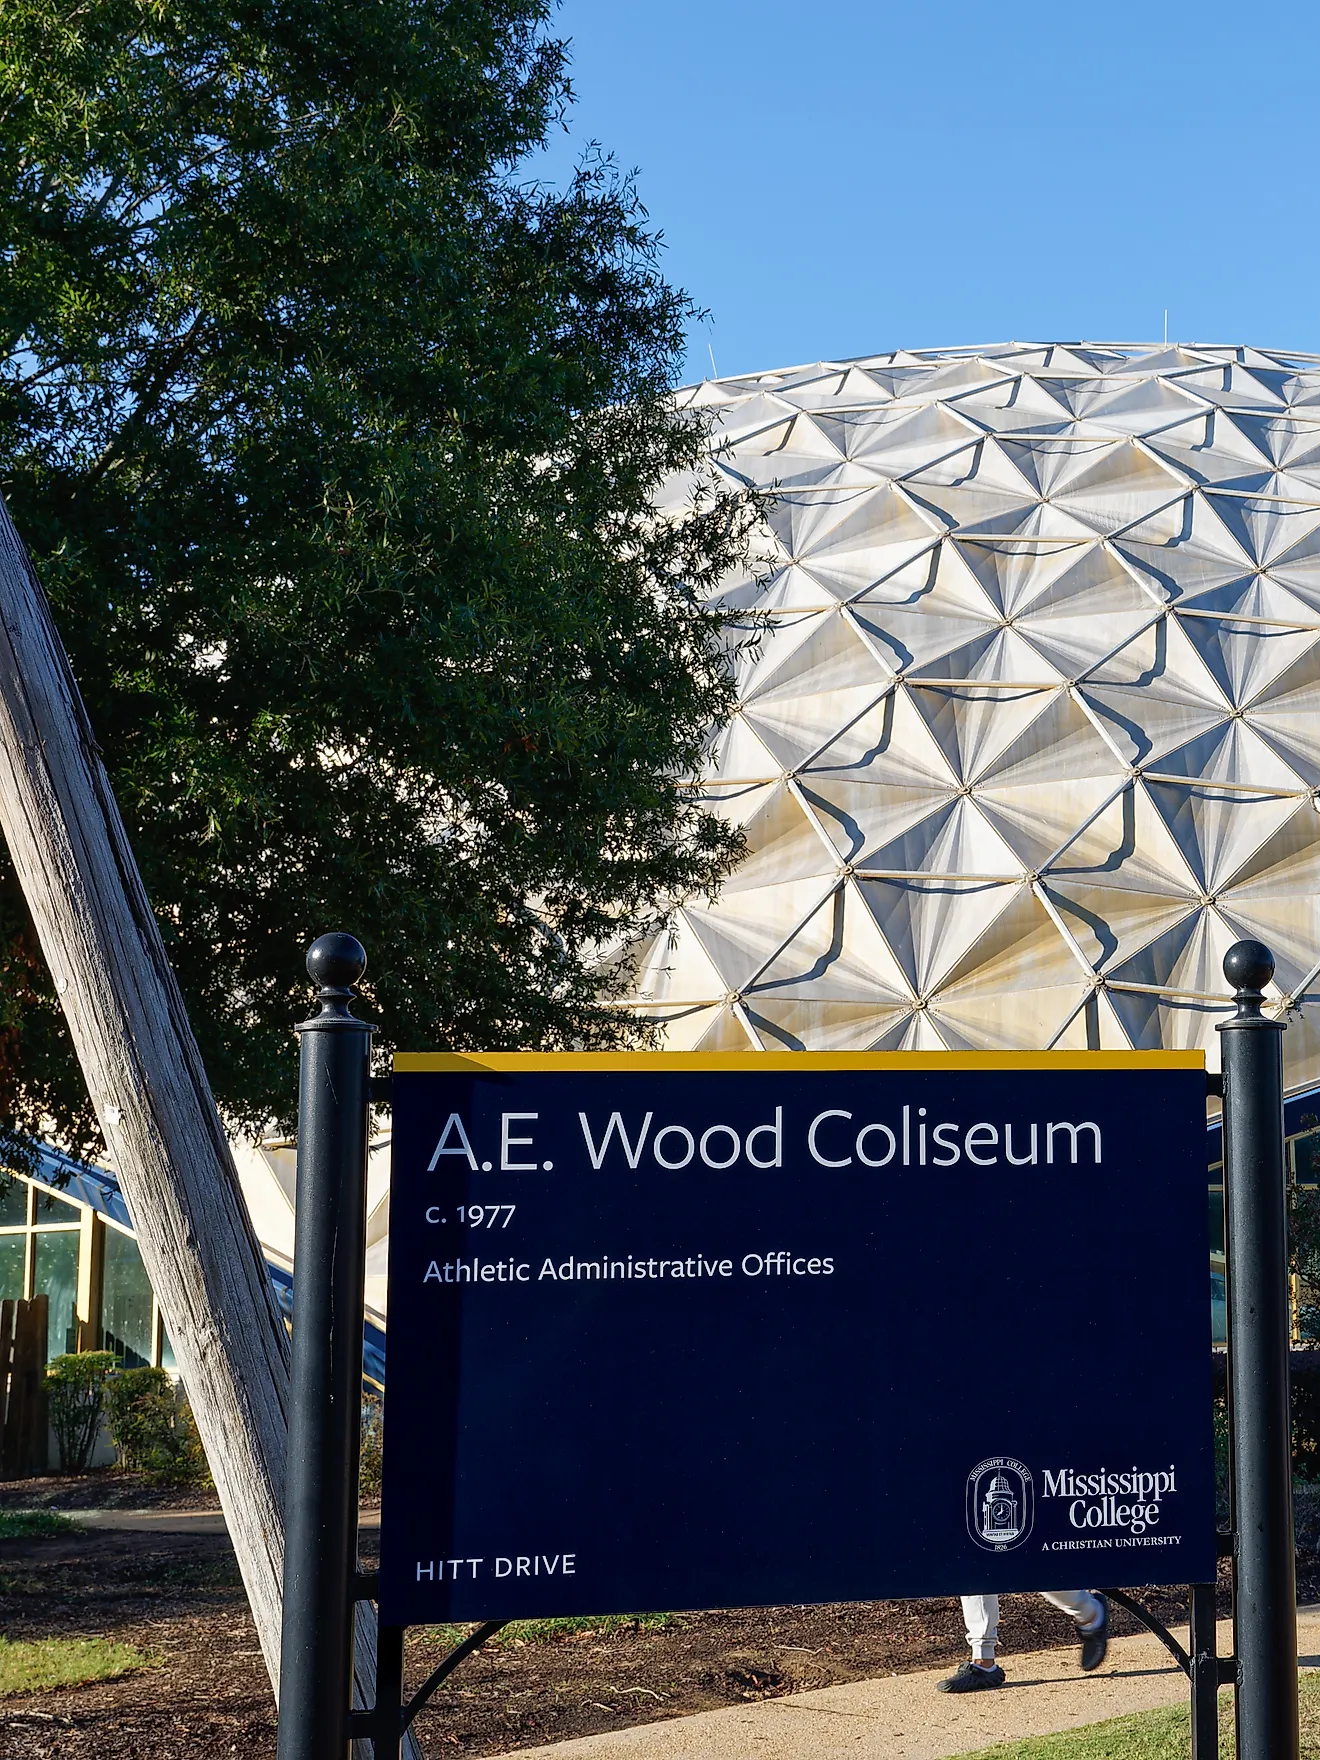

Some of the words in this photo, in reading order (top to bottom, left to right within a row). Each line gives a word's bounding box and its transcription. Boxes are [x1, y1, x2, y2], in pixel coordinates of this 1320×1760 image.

[428, 1112, 553, 1172] A.E.
[578, 1105, 783, 1170] Wood
[807, 1104, 1102, 1168] Coliseum
[425, 1206, 447, 1224] c.
[456, 1204, 516, 1229] 1977
[423, 1257, 531, 1283] Athletic
[538, 1253, 733, 1281] Administrative
[741, 1251, 835, 1277] Offices
[970, 1459, 1004, 1482] MISSISSIPPI
[1006, 1459, 1032, 1483] COLLEGE
[1041, 1464, 1178, 1502] Mississippi
[1069, 1496, 1160, 1535] College
[1041, 1541, 1050, 1551] A
[1051, 1538, 1113, 1551] CHRISTIAN
[1115, 1535, 1182, 1548] UNIVERSITY
[416, 1558, 484, 1582] HITT
[495, 1553, 576, 1578] DRIVE
